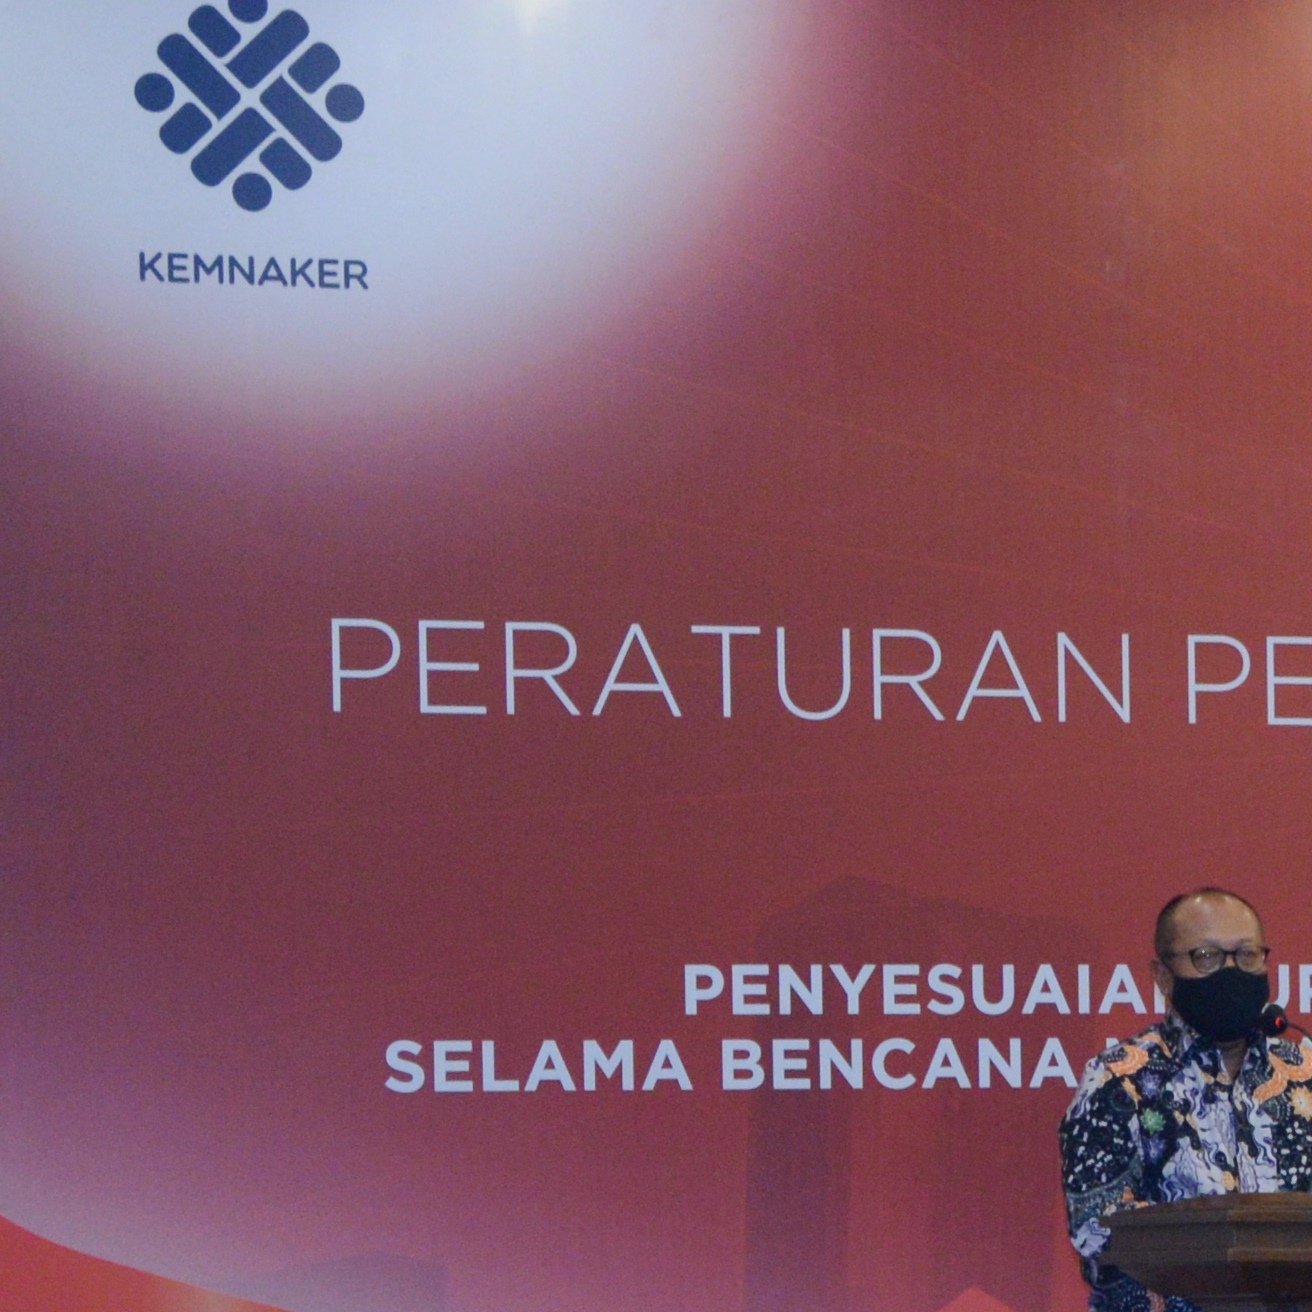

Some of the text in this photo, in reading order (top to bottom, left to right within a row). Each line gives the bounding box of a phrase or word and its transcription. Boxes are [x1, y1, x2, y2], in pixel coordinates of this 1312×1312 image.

[138, 251, 369, 291] KEMNAKER
[331, 617, 1131, 724] PERATURAN
[384, 1038, 693, 1094] SELAMA
[721, 1037, 1079, 1090] BENCANA
